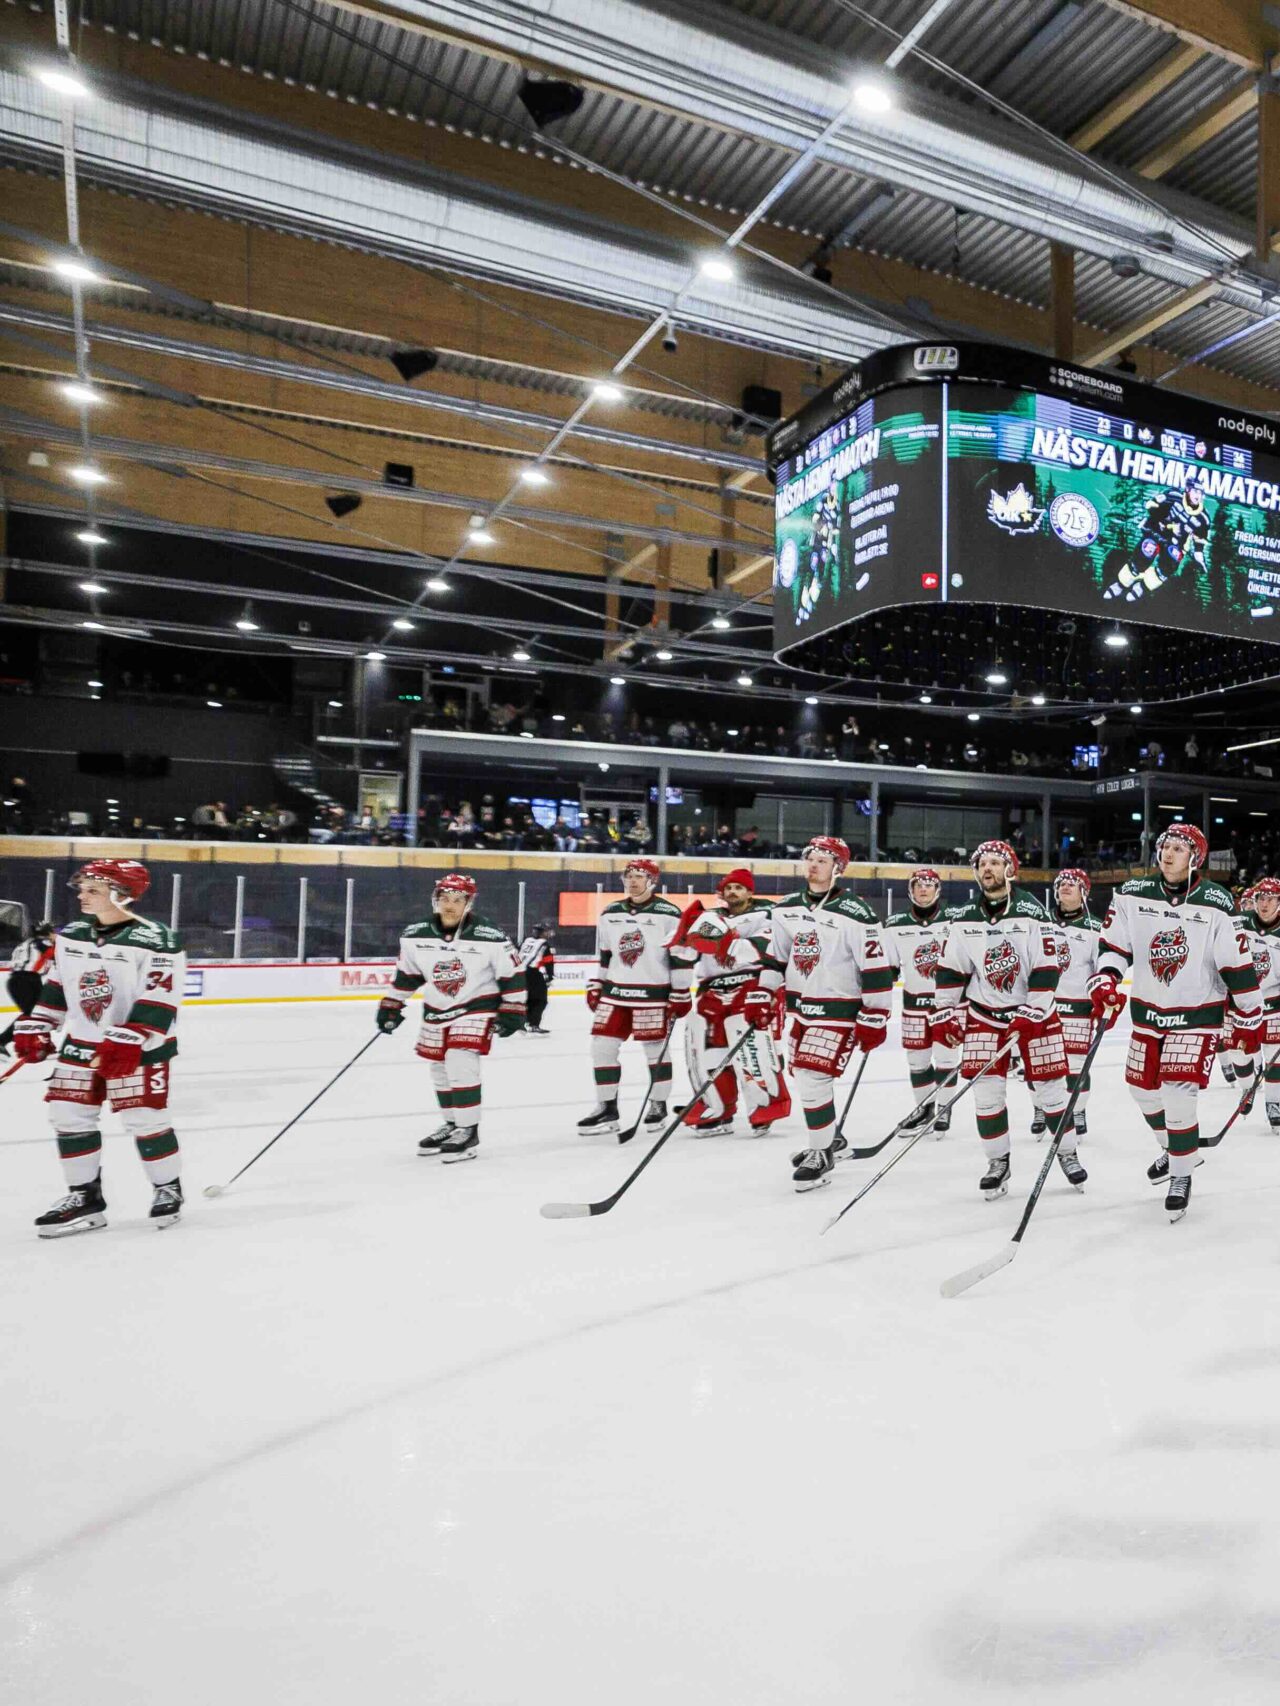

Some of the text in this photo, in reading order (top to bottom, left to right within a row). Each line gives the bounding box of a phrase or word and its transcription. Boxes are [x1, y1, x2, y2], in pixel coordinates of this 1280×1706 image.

[1058, 368, 1123, 394] SCOREBOARD
[1218, 416, 1276, 445] nodeply
[1031, 426, 1118, 474] NÄSTA
[1234, 530, 1264, 546] FREDAG
[1238, 544, 1280, 563] ÖSTERSUND
[1042, 937, 1056, 956] 5
[1150, 945, 1187, 958] MODO
[986, 954, 1018, 974] MODO
[146, 970, 174, 991] 34
